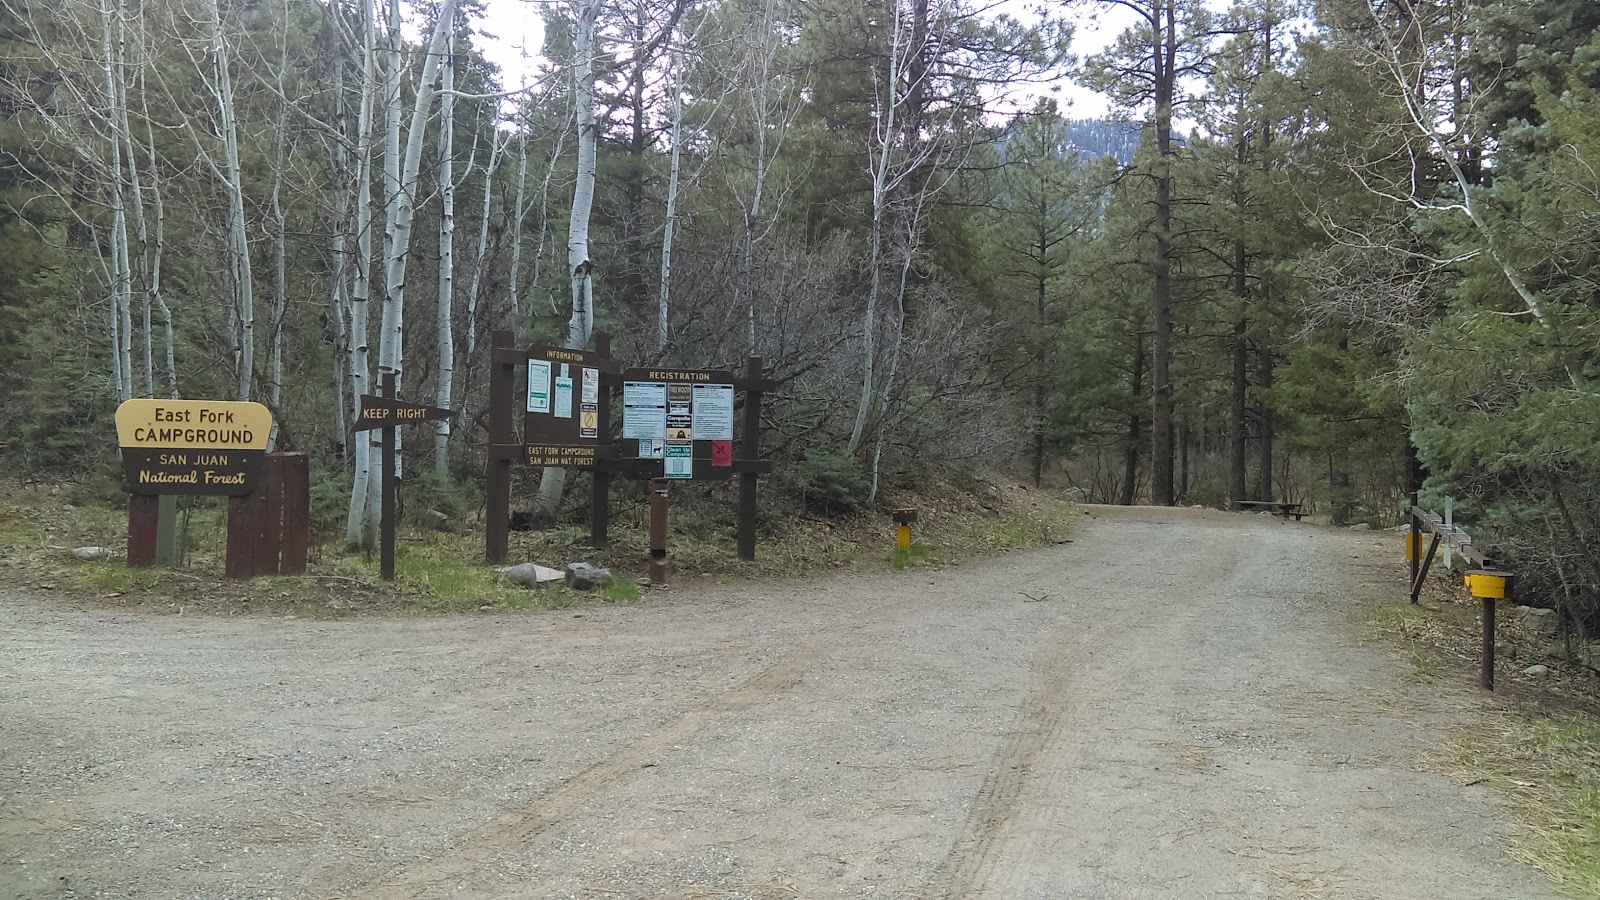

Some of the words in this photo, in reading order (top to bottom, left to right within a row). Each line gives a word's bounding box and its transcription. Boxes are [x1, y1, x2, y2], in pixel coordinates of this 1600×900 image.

[546, 350, 584, 362] INFORMATION
[649, 371, 710, 380] REGISTRATION
[155, 408, 191, 422] East
[200, 409, 234, 423] Fork
[363, 408, 390, 419] KEEP
[396, 408, 427, 419] RIGHT
[134, 428, 253, 443] CAMPGROUND
[528, 446, 542, 455] EAST
[544, 447, 559, 455] FORK
[561, 447, 595, 456] CAMPGROUND
[160, 454, 187, 465] SAN
[193, 454, 228, 466] JUAN
[530, 457, 542, 465] SAN
[544, 457, 559, 465] JUAN
[574, 457, 594, 465] FOREST
[139, 469, 198, 484] National
[204, 470, 246, 484] Forest
